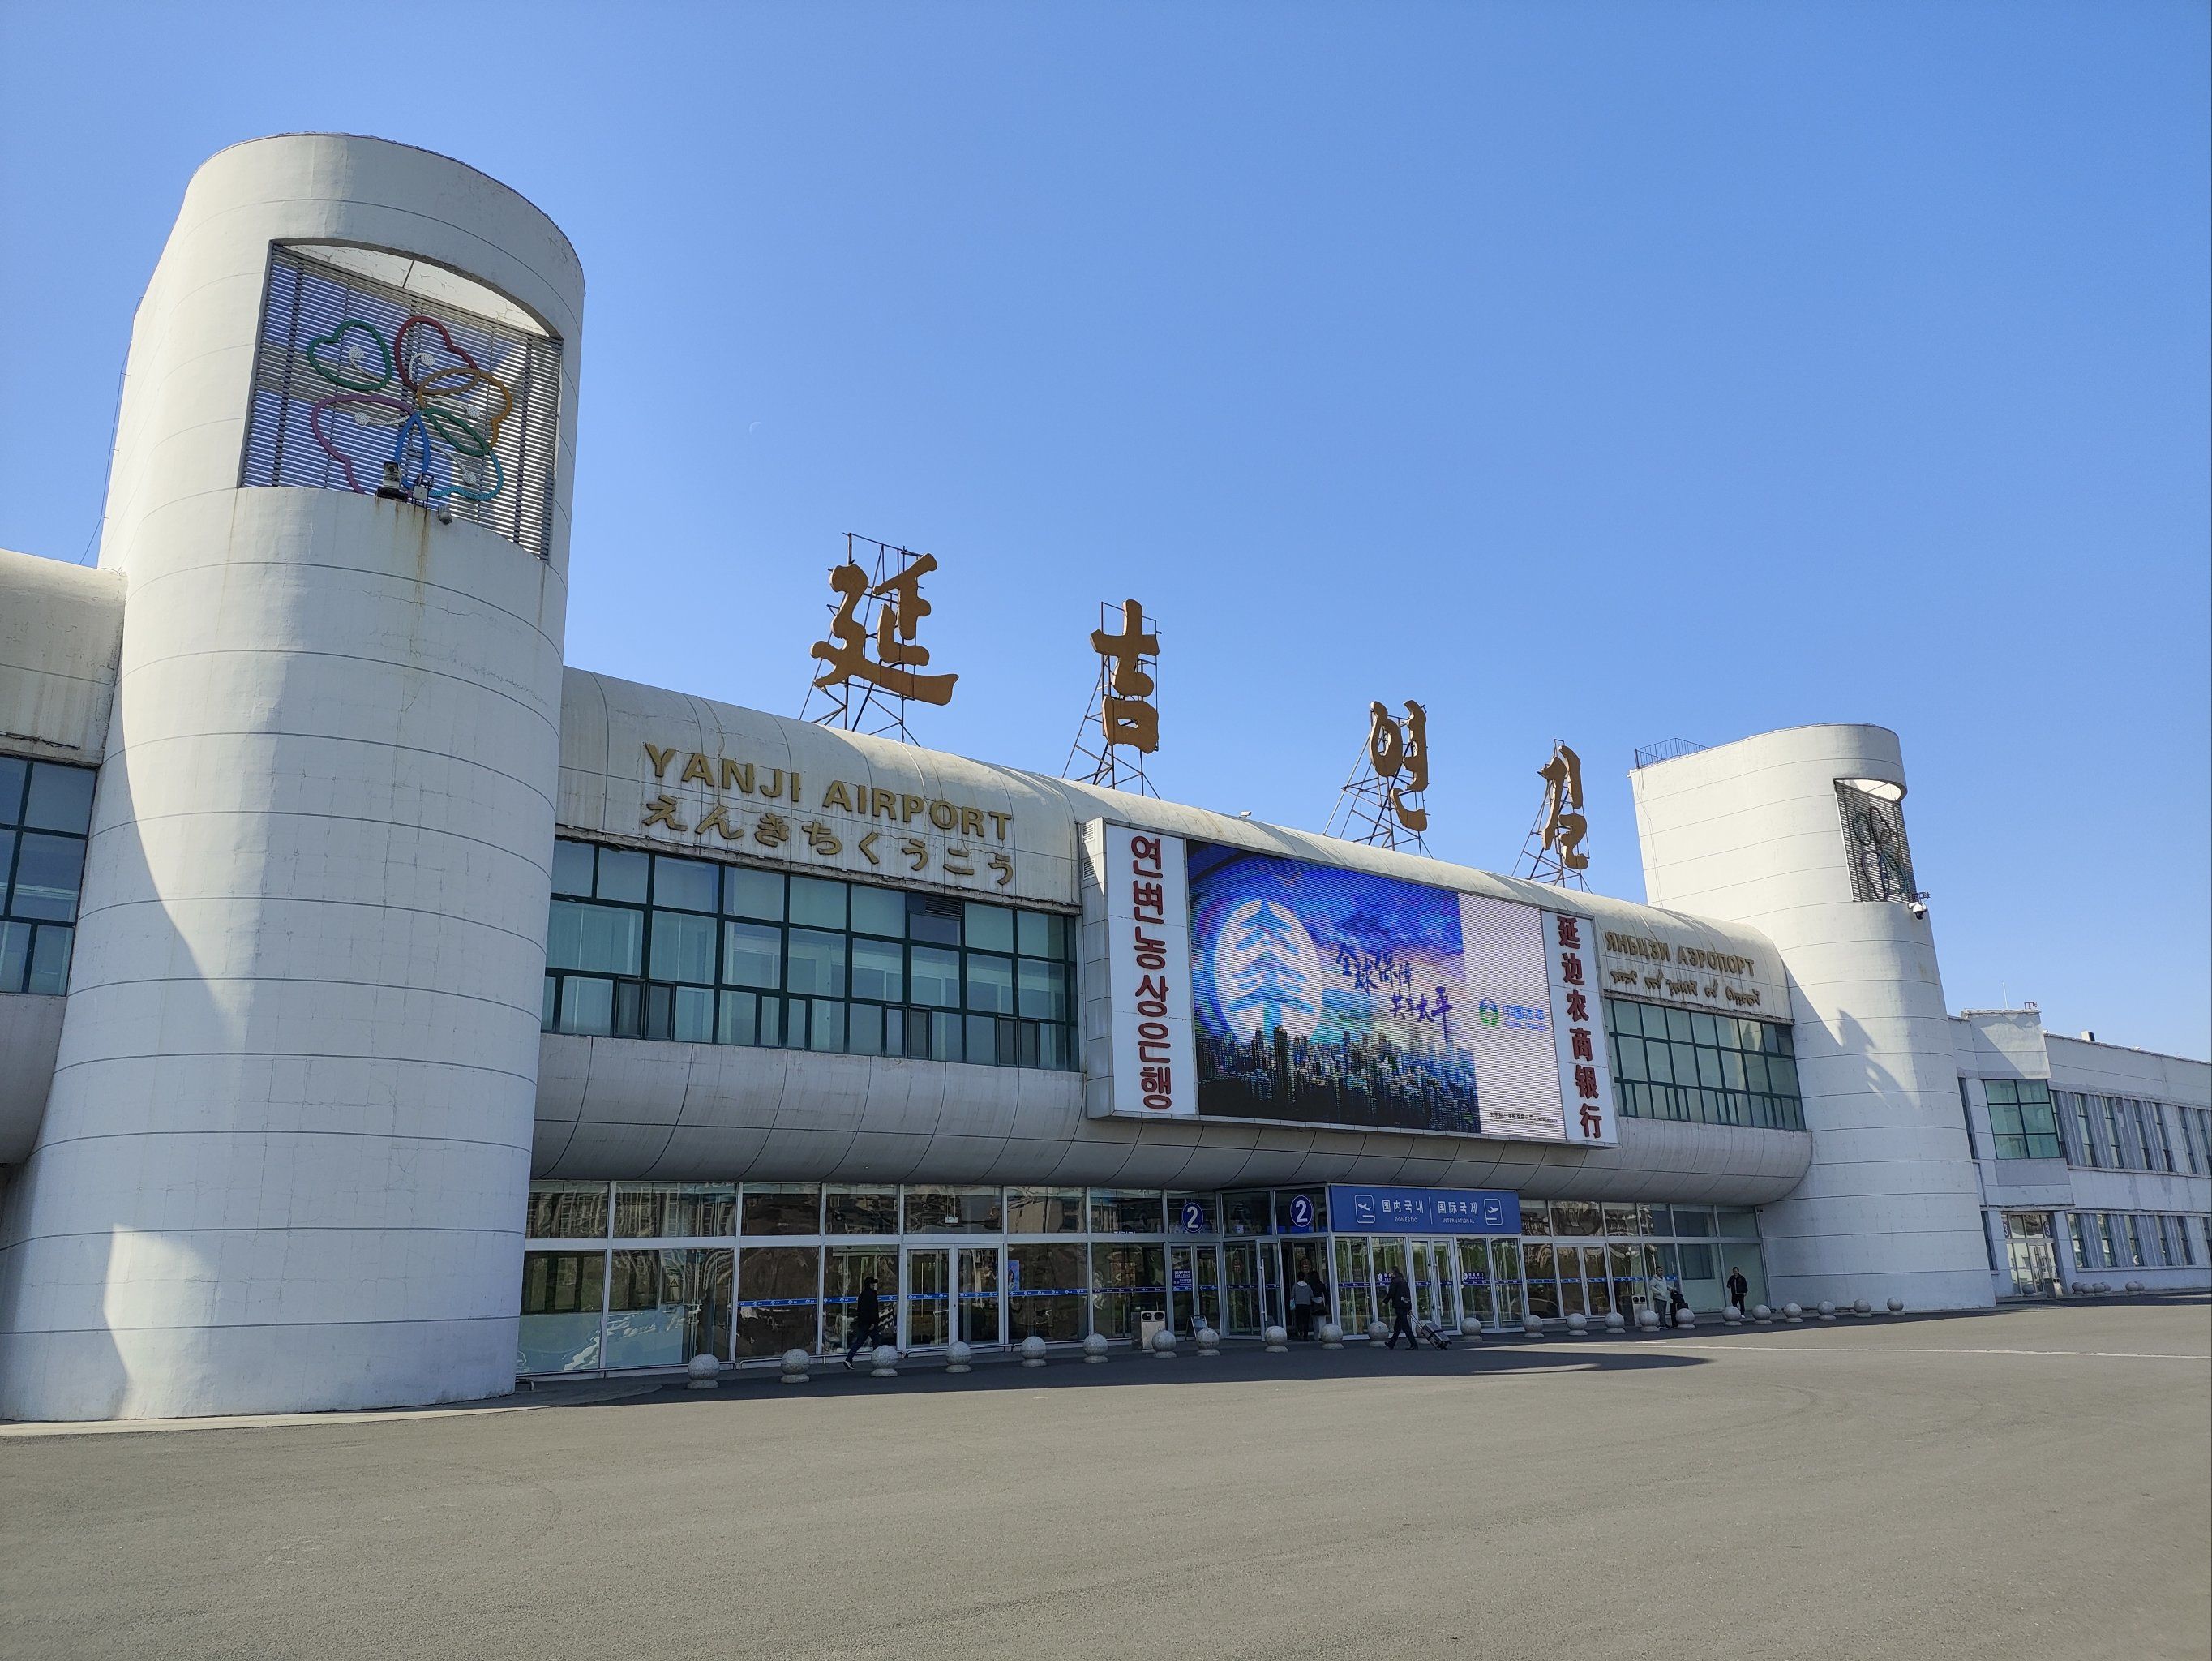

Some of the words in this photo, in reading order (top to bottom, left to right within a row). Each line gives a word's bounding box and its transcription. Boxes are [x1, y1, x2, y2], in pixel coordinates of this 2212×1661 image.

[645, 743, 800, 801] YANJI
[823, 780, 1012, 840] AIRPORT
[643, 795, 1014, 886] えんきちくうこう
[1131, 835, 1172, 1110] 연변농상은행
[1678, 946, 1755, 977] АЭРОПОРТ
[1557, 916, 1602, 1139] 延边农商银行
[1186, 1205, 1198, 1229] 2
[1295, 1200, 1308, 1223] 2
[1382, 1199, 1402, 1213] 国内
[1404, 1200, 1424, 1214] 국내
[1437, 1200, 1457, 1214] 国际
[1460, 1201, 1478, 1216] 국제
